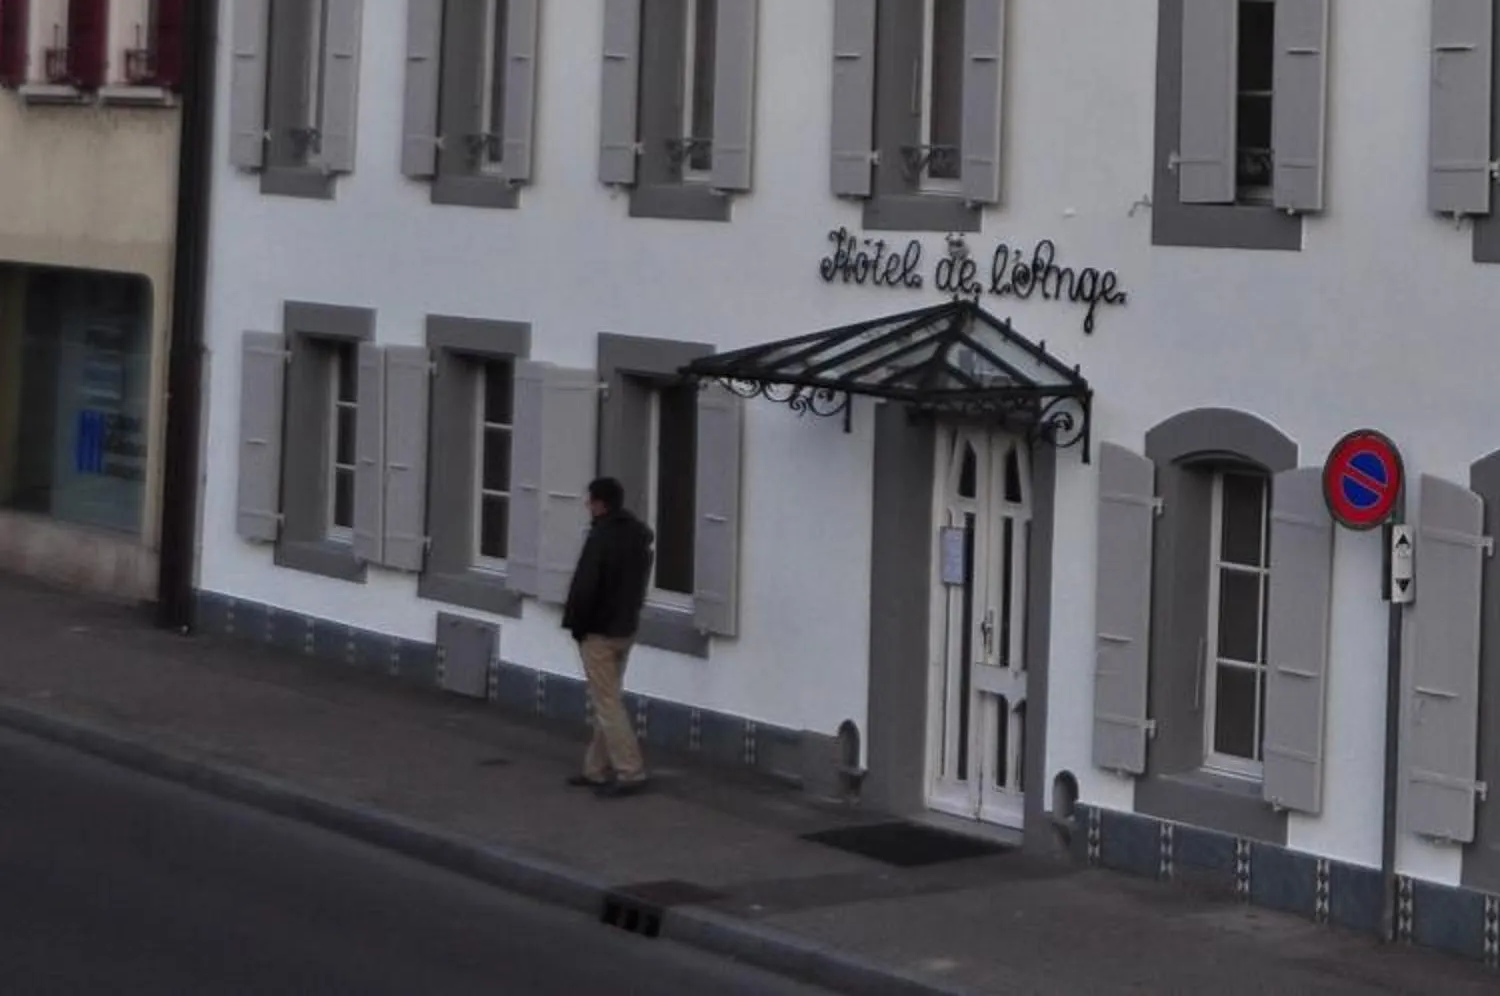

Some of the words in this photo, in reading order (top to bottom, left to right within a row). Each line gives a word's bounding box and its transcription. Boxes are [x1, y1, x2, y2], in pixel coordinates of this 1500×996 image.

[820, 226, 923, 289] Hôtel
[935, 242, 982, 294] de
[988, 239, 1127, 334] l'Ange
